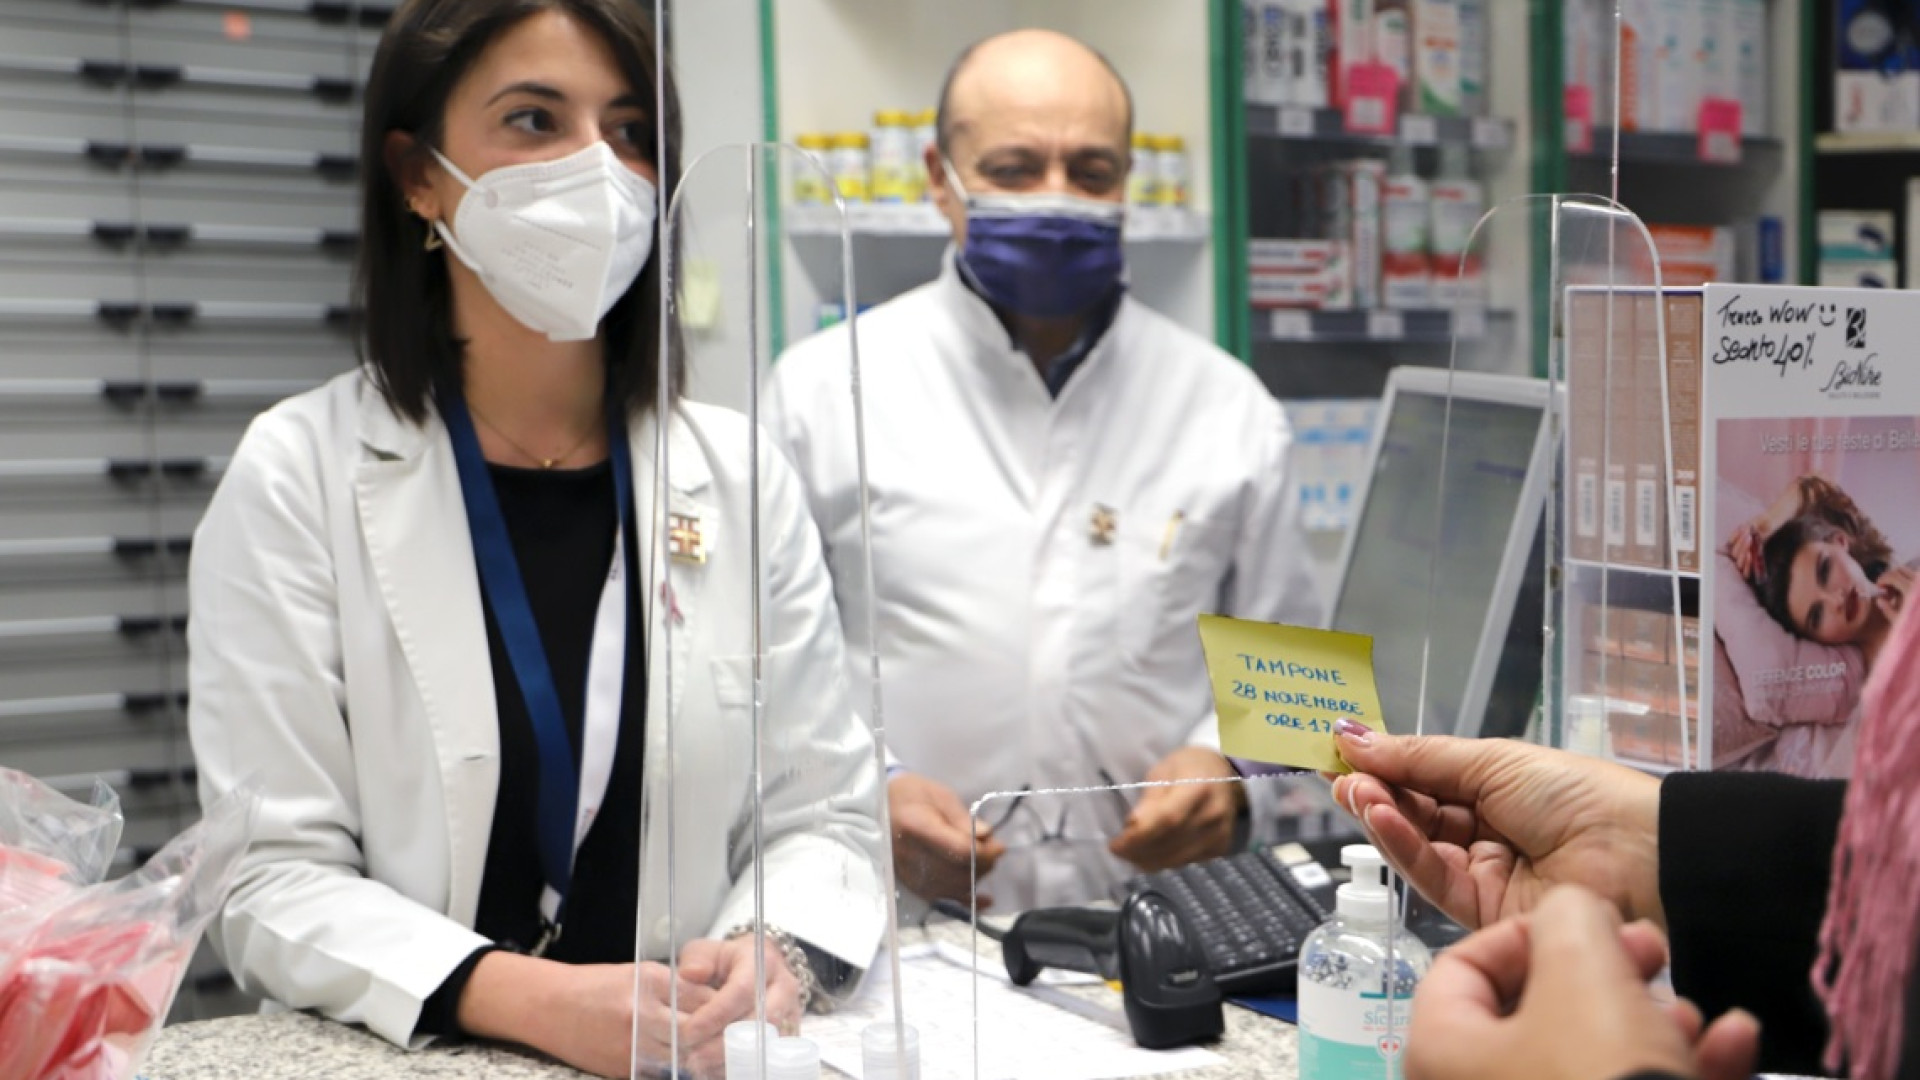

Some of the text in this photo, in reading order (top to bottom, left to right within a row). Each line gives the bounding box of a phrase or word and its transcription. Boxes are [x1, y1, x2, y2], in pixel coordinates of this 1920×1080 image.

[1237, 654, 1347, 685] TAMPONE
[1806, 662, 1847, 680] COLOR
[1231, 680, 1365, 716] 28 NOVEMBRE
[1265, 714, 1305, 732] ORE
